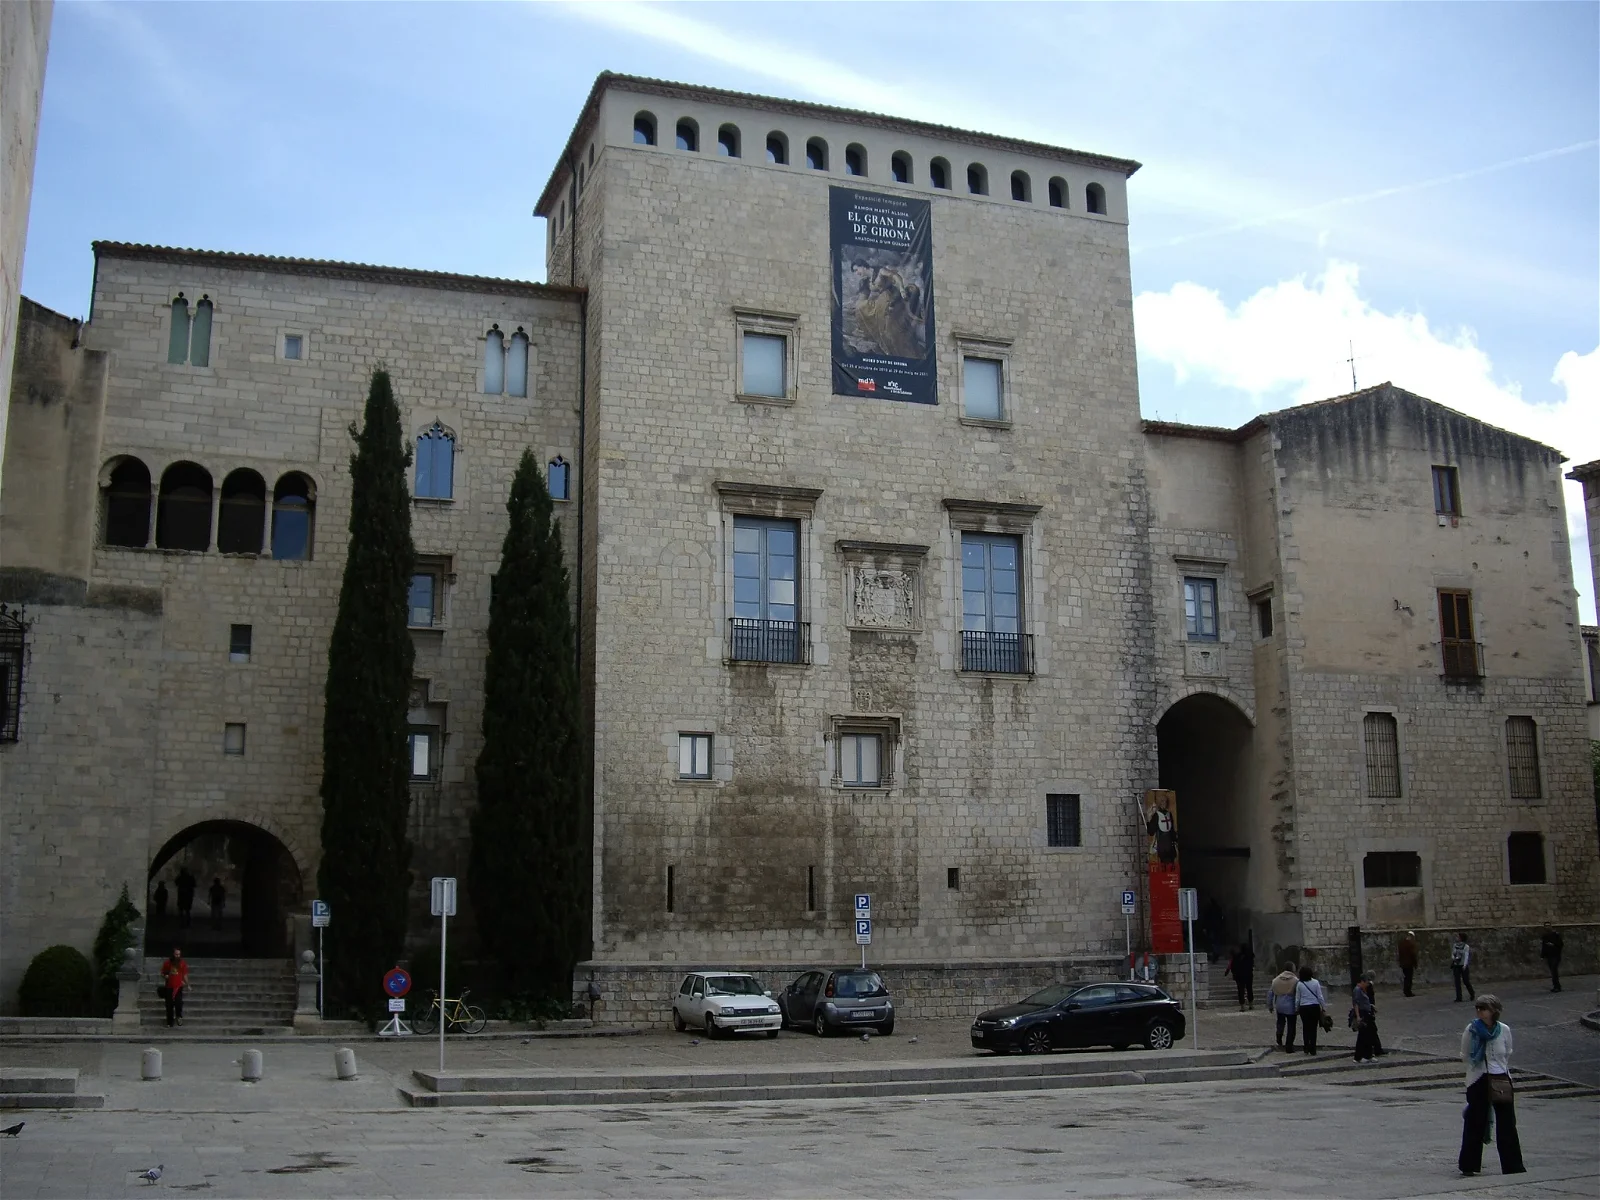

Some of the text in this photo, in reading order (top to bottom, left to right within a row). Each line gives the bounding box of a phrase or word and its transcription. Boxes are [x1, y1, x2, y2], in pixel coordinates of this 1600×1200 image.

[848, 211, 915, 230] EL GRAN DIA
[853, 223, 911, 241] DE GIRONA
[859, 897, 867, 908] P
[1125, 894, 1131, 903] P
[317, 903, 326, 914] P
[859, 922, 868, 933] P
